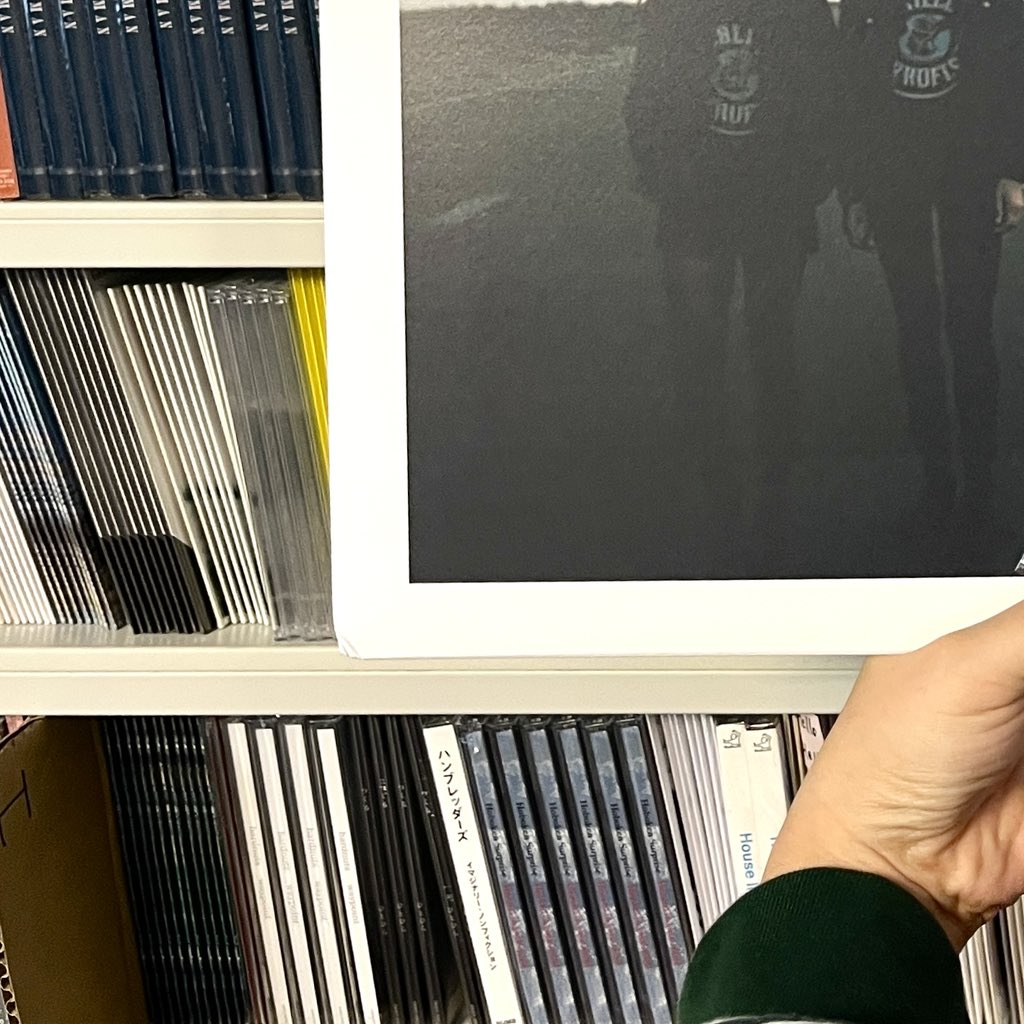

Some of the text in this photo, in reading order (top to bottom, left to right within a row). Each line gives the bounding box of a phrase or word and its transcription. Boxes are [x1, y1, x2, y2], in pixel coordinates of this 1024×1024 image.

[438, 750, 469, 843] ハンブレッダーズ
[740, 833, 755, 879] House
